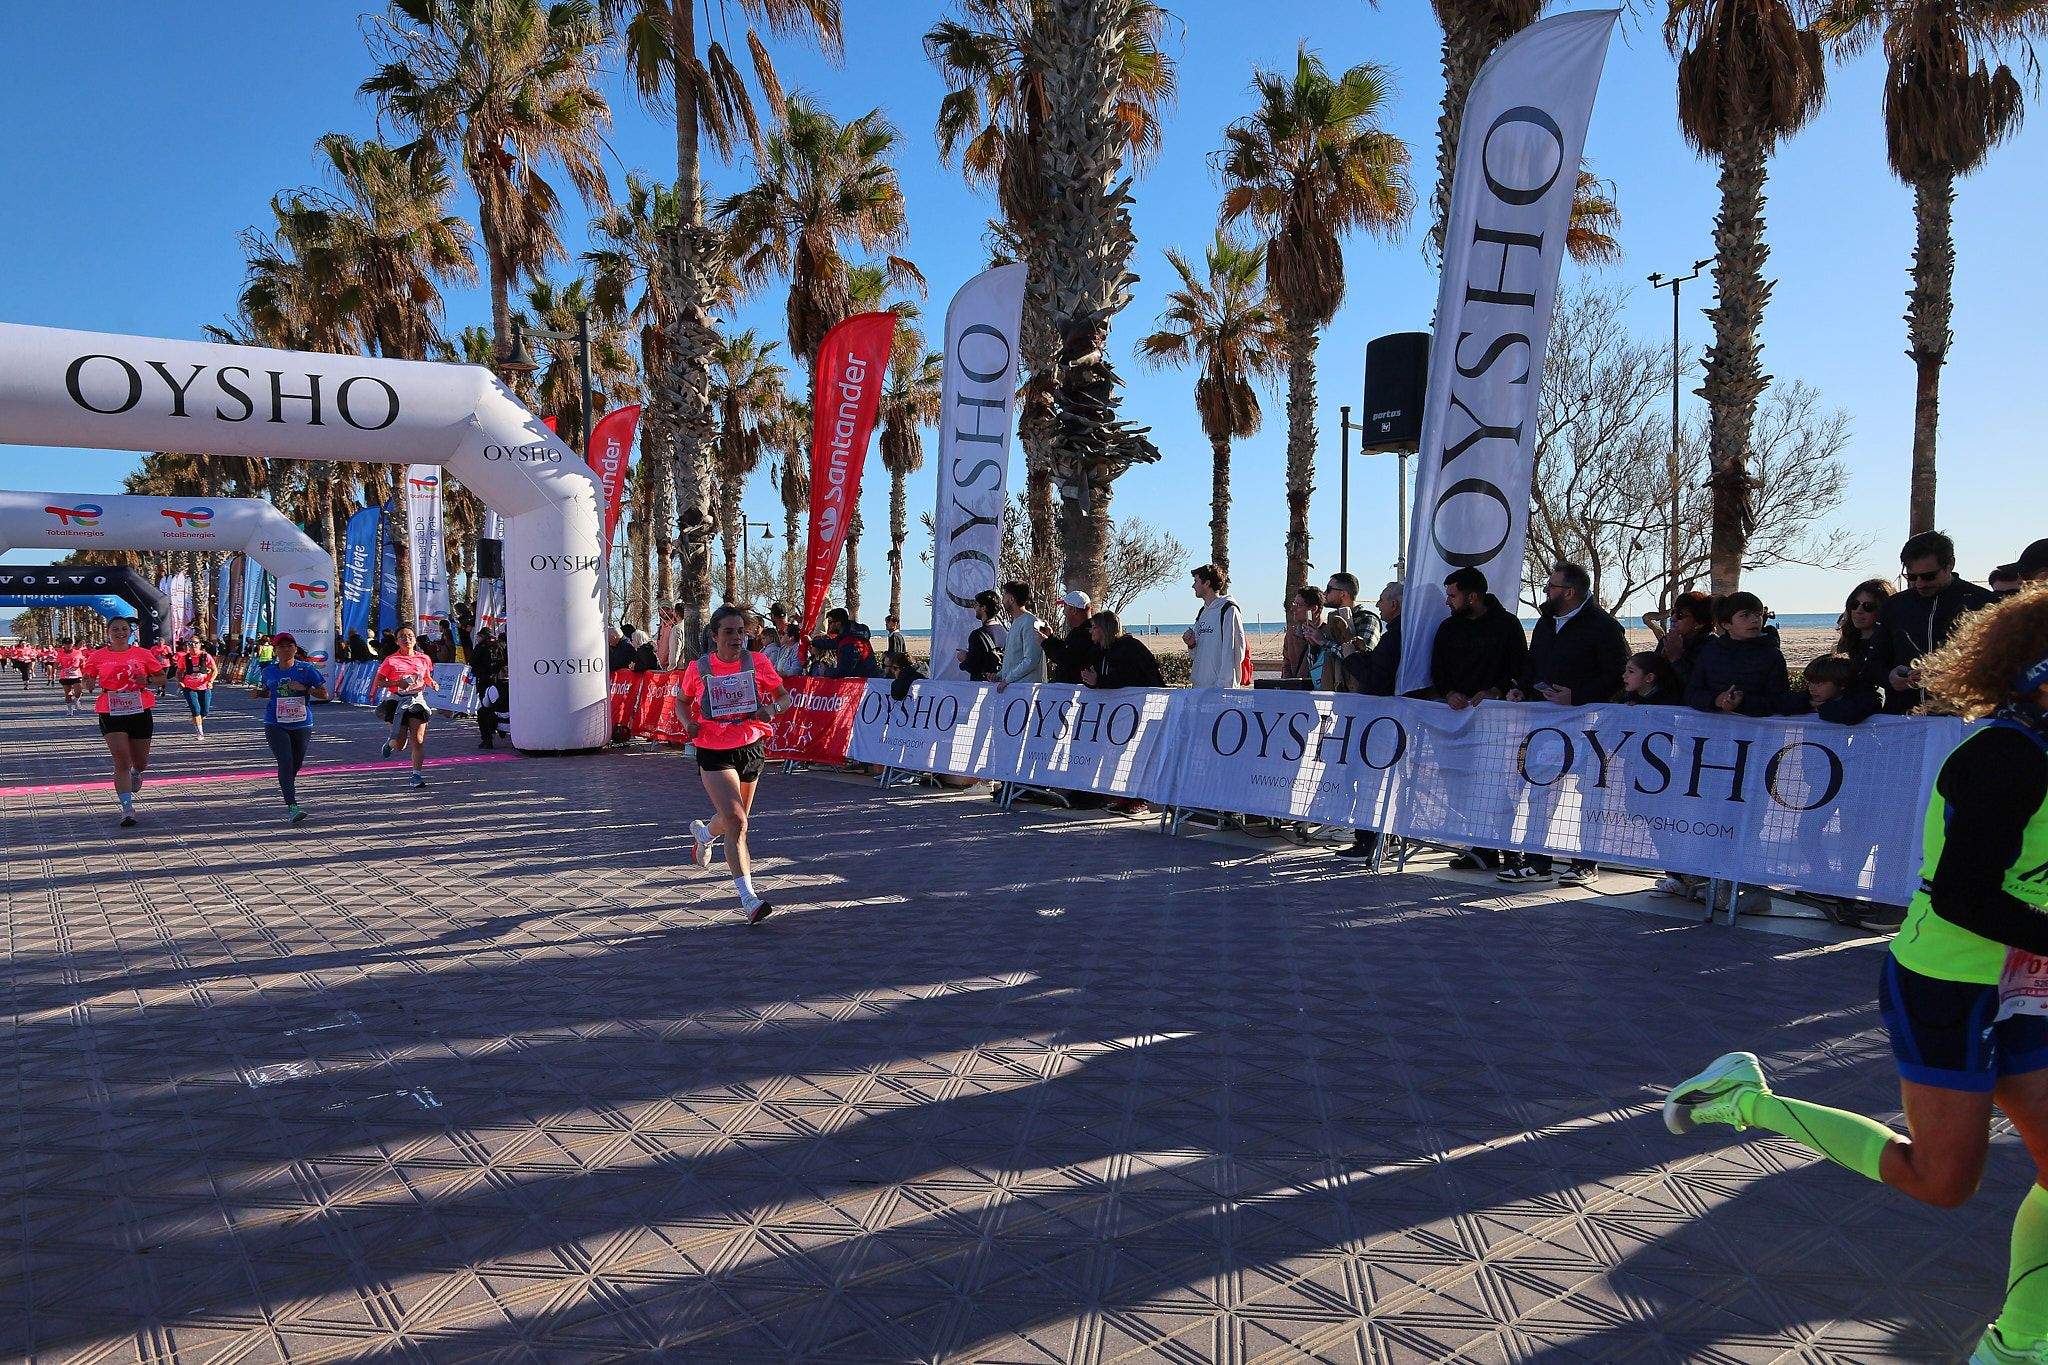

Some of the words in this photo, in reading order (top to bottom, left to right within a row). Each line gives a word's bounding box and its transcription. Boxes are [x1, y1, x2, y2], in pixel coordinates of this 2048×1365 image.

[1431, 105, 1565, 567] OYSHO
[65, 353, 401, 431] OYSHO
[483, 444, 562, 464] OYSHO
[946, 323, 1011, 609] OYSHO
[46, 529, 105, 538] TotalEnergies
[161, 531, 216, 539] TotalEnergies
[0, 576, 107, 585] VOLVO
[344, 545, 374, 603] Marlene
[530, 555, 601, 572] OYSHO
[533, 657, 604, 676] OYSHO
[789, 688, 849, 711] Santander
[861, 691, 958, 732] OYSHO
[1003, 698, 1138, 746] OYSHO
[1211, 708, 1407, 770] OYSHO
[1517, 727, 1843, 811] OYSHO
[1586, 809, 1734, 840] WWW.OYSHO.COM
